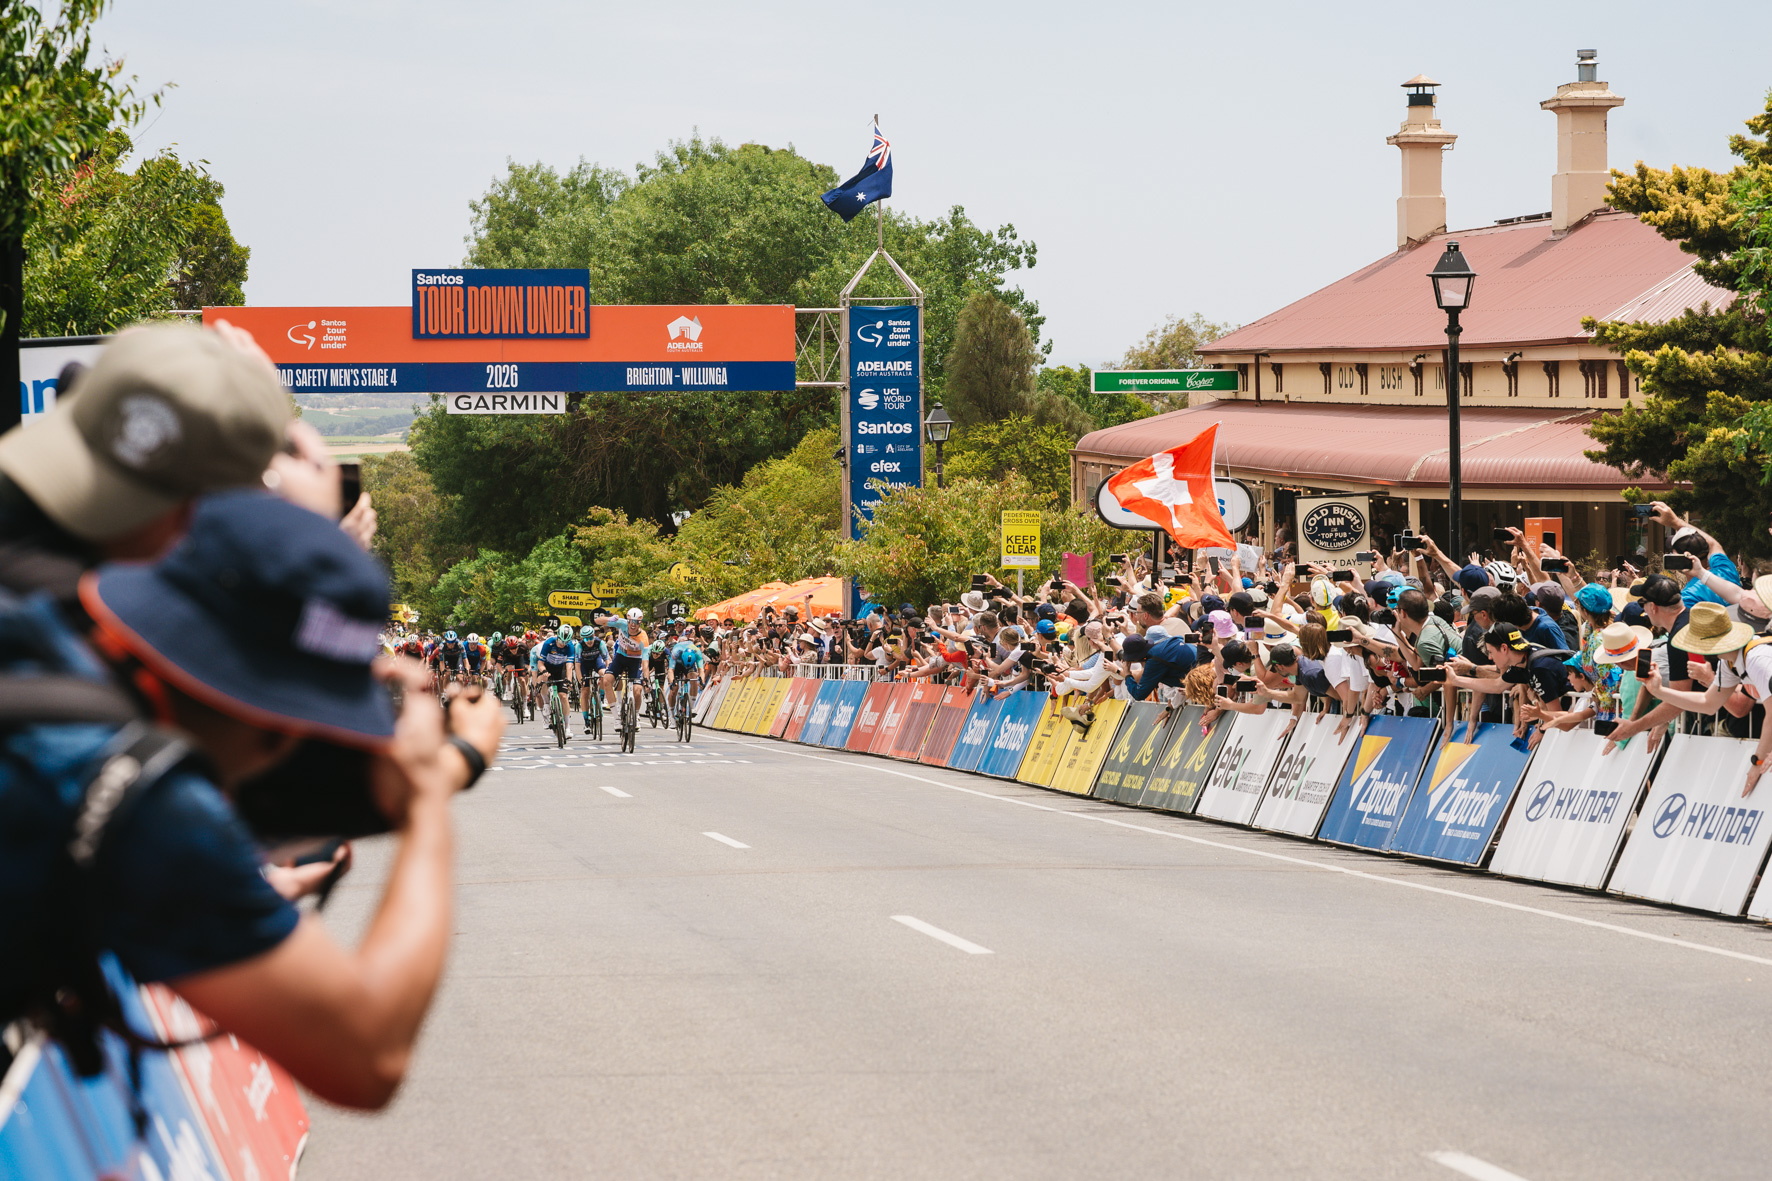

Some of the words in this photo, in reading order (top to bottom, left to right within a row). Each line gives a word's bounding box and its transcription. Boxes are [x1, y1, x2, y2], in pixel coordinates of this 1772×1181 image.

[416, 274, 464, 284] Santos
[416, 286, 464, 334] TOUR
[468, 286, 524, 334] DOWN
[526, 286, 586, 334] UNDER
[486, 364, 518, 388] 2026
[626, 368, 672, 385] BRIGHTON
[682, 368, 728, 385] WILLUNGA
[857, 361, 912, 371] ADELAIDE
[296, 369, 328, 386] SAFETY
[330, 369, 359, 386] MEN'S
[361, 369, 388, 386] STAGE
[390, 369, 397, 386] 4
[1186, 372, 1214, 390] Coopers
[1339, 367, 1354, 388] OLD
[1381, 367, 1402, 390] BUSH
[454, 395, 558, 410] GARMIN
[858, 421, 912, 434] Santos
[870, 460, 901, 472] efex
[1308, 508, 1328, 526] OLD
[1333, 506, 1360, 525] BUSH
[1324, 518, 1344, 526] INN
[1006, 535, 1036, 544] KEEP
[1006, 545, 1036, 554] CLEAR
[672, 604, 686, 614] 25
[809, 699, 831, 724] Santos
[832, 700, 854, 728] Santos
[962, 712, 990, 746] Santos
[994, 715, 1029, 751] Santos
[1213, 735, 1251, 790] efex
[1272, 743, 1316, 800] efex
[1356, 769, 1408, 824] Ziptrak
[1435, 778, 1501, 835] Ziptrak
[1549, 787, 1623, 824] HYUNDAI
[1681, 802, 1764, 845] HYUNDAI
